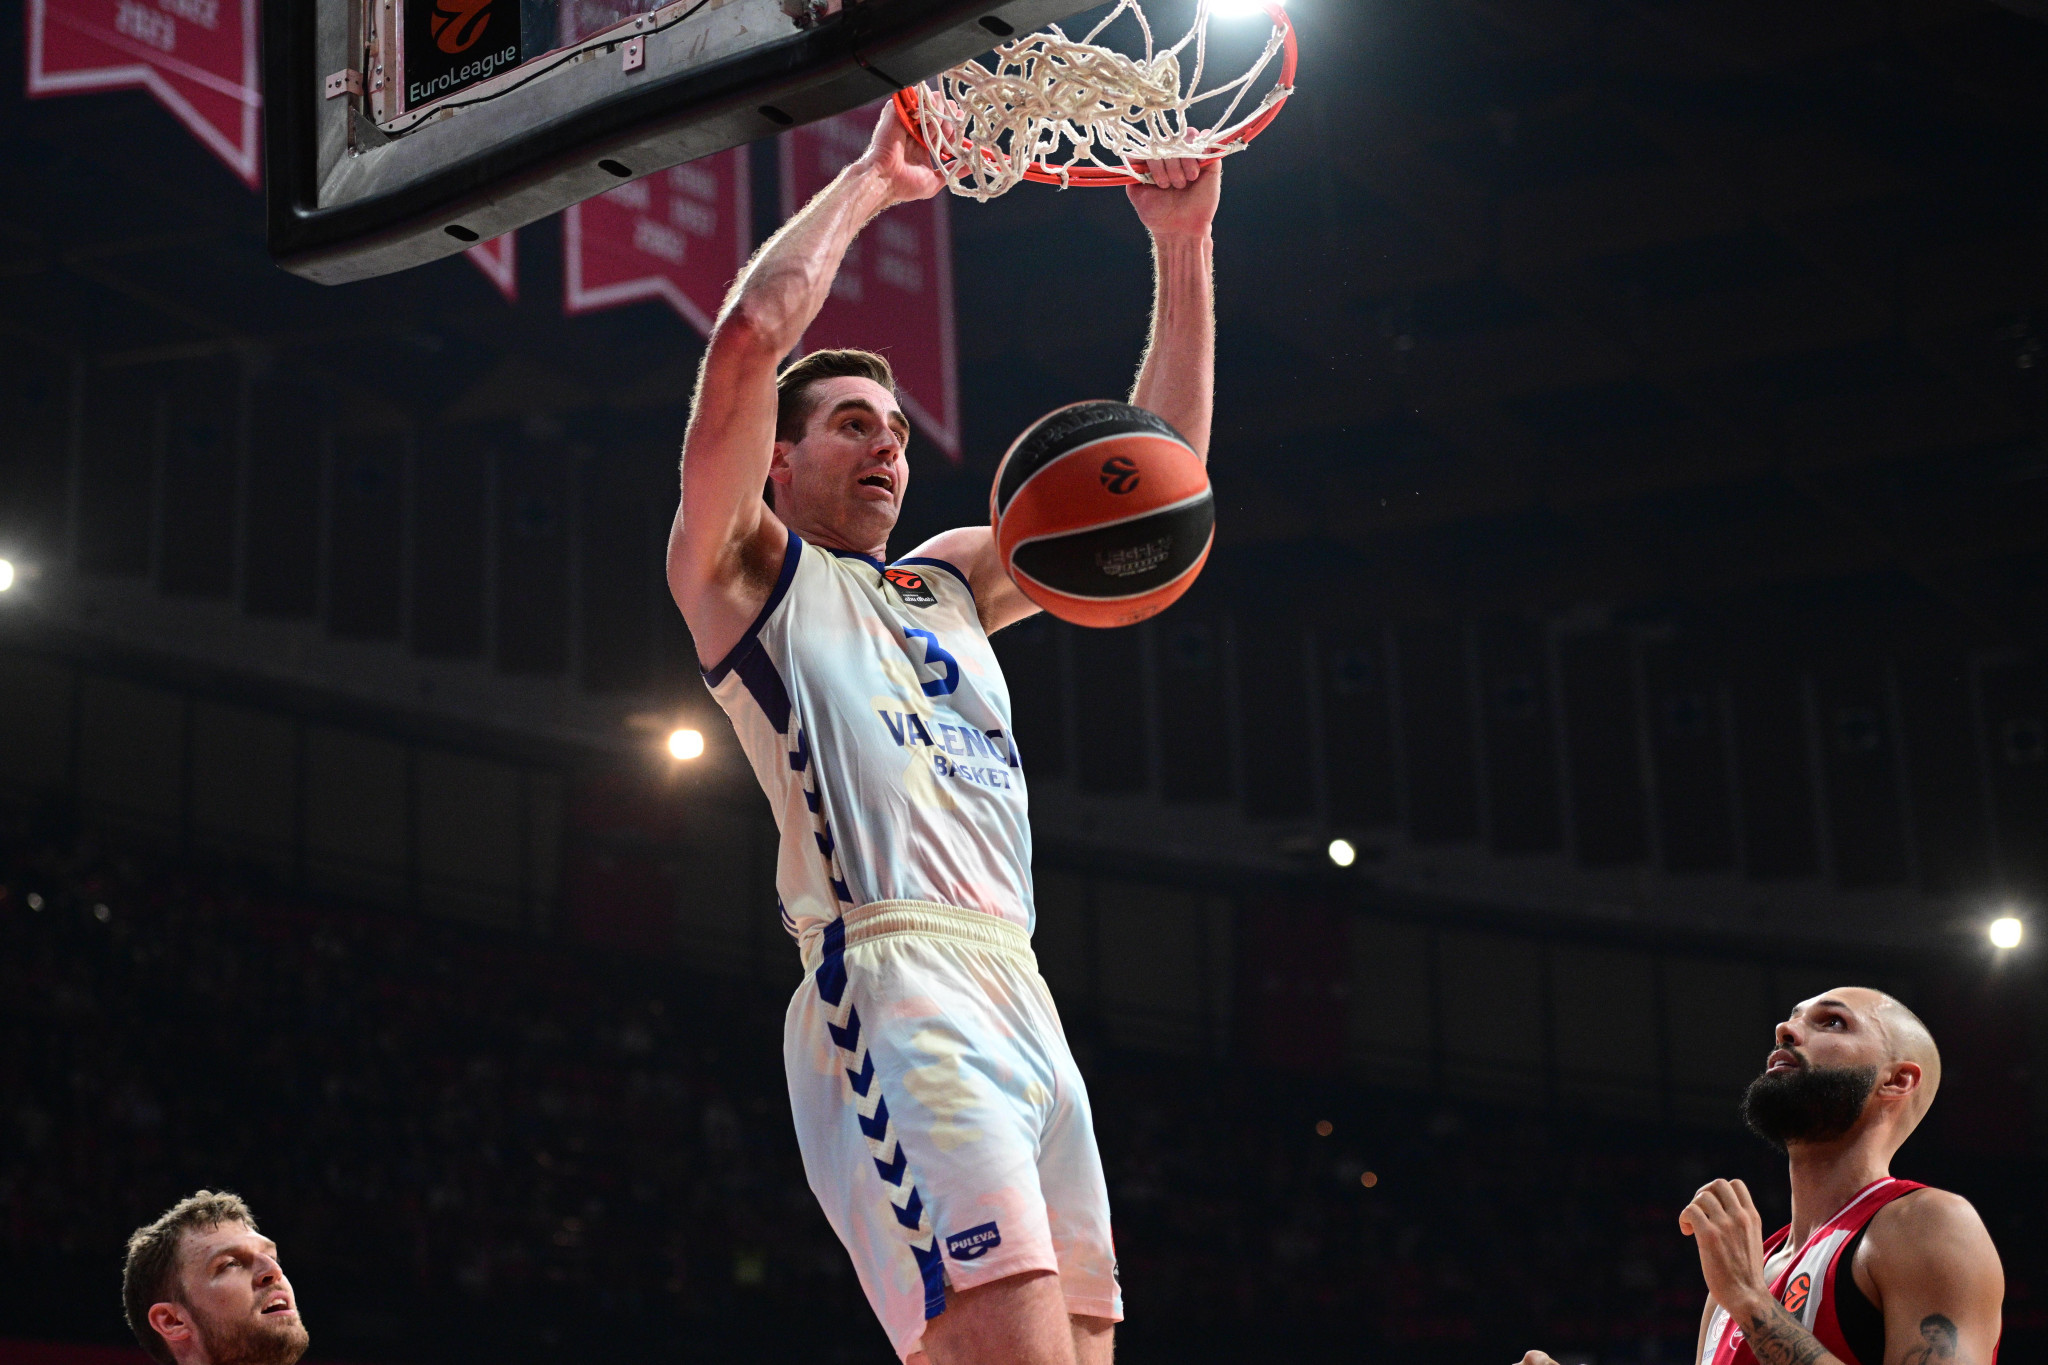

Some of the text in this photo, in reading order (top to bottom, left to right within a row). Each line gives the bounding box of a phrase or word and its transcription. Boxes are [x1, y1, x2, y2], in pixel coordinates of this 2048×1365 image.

[410, 45, 516, 103] EuroLeague
[903, 625, 960, 698] 3
[877, 709, 1023, 768] VALENCI
[933, 754, 1011, 790] BASKET
[950, 1230, 997, 1253] PULEVA
